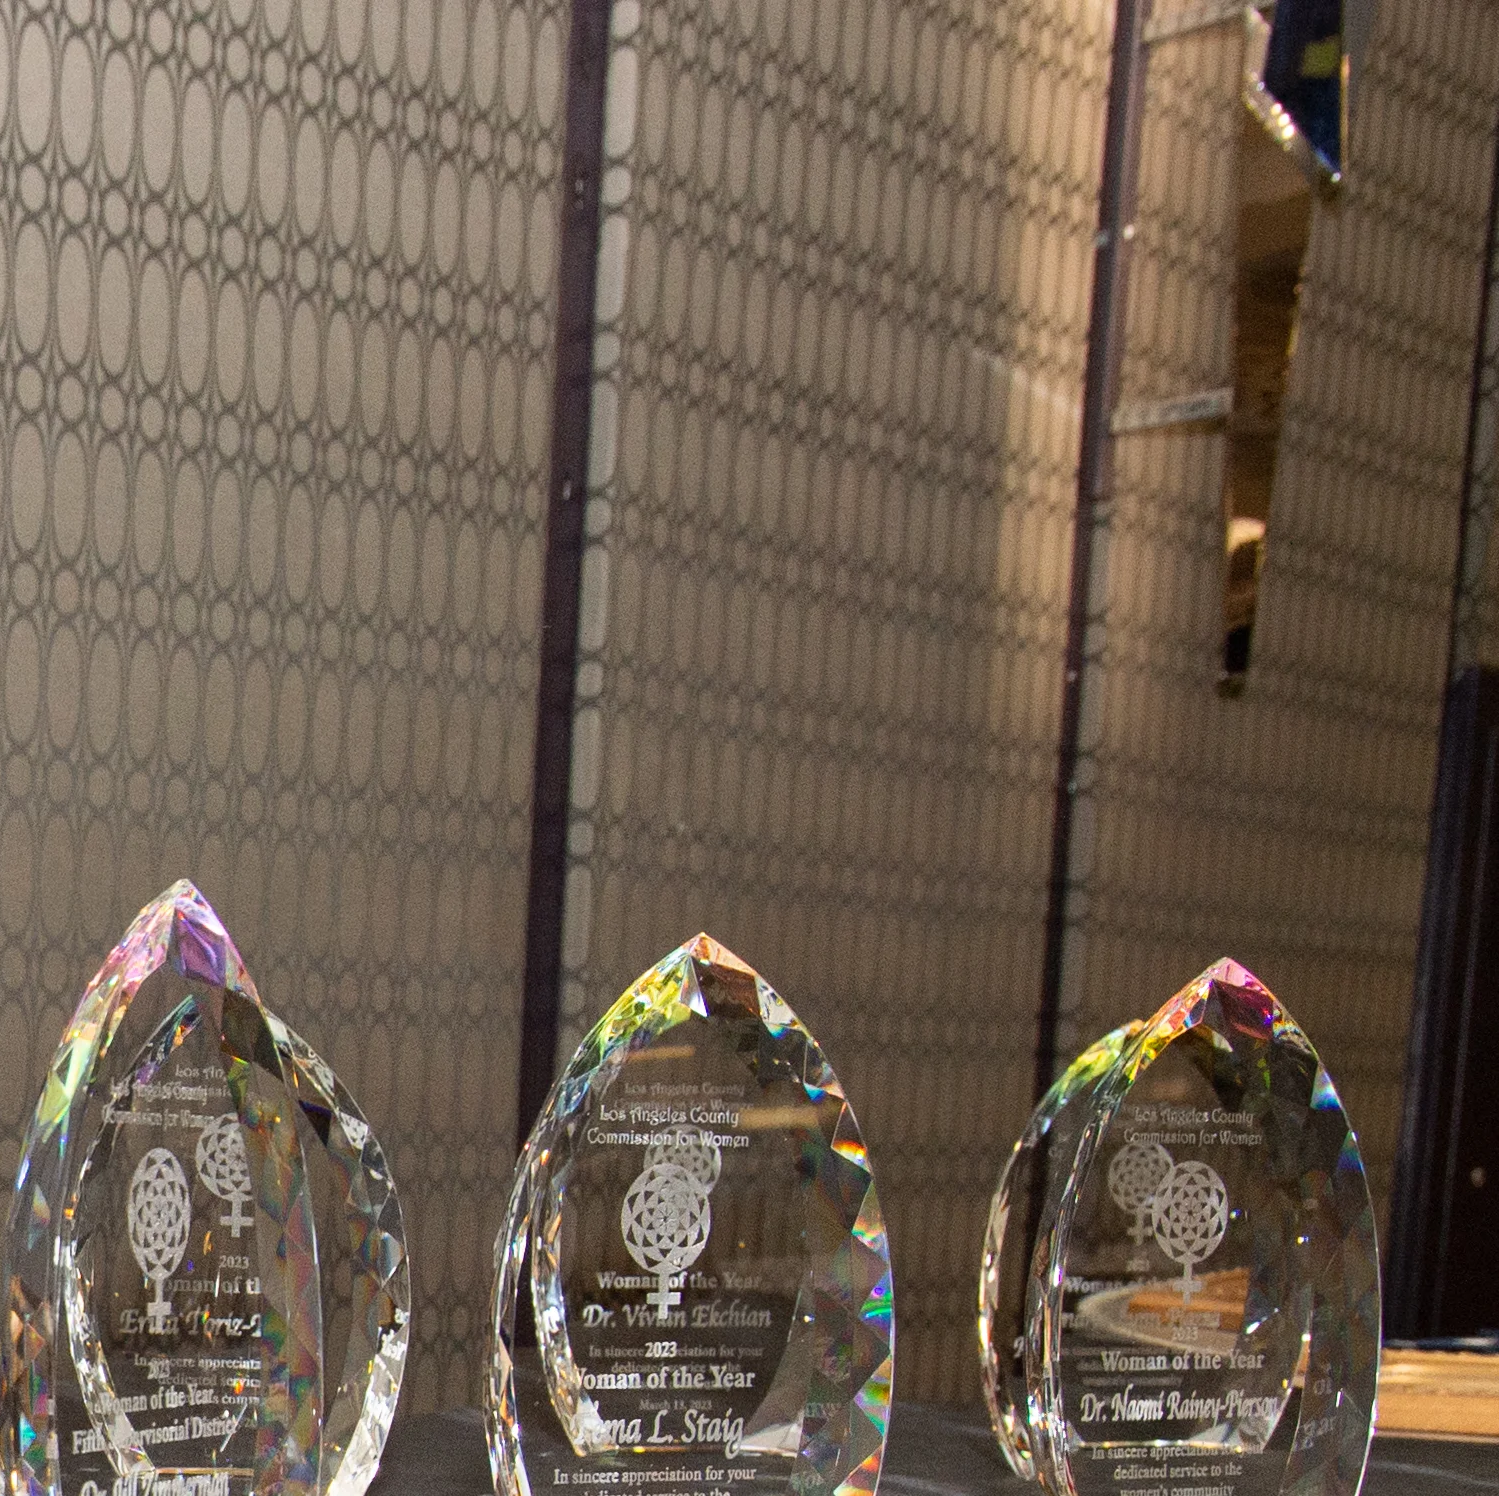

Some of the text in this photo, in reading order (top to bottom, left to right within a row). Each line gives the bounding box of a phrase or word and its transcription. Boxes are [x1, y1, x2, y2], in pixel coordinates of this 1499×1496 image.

[175, 1064, 199, 1078] Los
[600, 1105, 626, 1122] Los
[630, 1106, 686, 1125] Angeles
[690, 1106, 740, 1127] County
[1134, 1107, 1253, 1126] Los Angeles County
[587, 1127, 749, 1149] Commission for Women
[1123, 1128, 1262, 1147] Commission for Women
[219, 1255, 250, 1269] 2023
[222, 1276, 242, 1295] of
[668, 1272, 687, 1289] of
[689, 1272, 718, 1289] the
[722, 1271, 762, 1289] Year
[582, 1304, 616, 1328] Dr.
[691, 1295, 772, 1328] Ekchian
[645, 1341, 677, 1358] 2023
[1101, 1350, 1168, 1372] Woman
[1172, 1349, 1192, 1370] of
[1194, 1349, 1222, 1370] the
[1227, 1349, 1265, 1369] Year
[646, 1366, 667, 1389] of
[672, 1366, 705, 1389] the
[709, 1365, 756, 1388] Year
[151, 1387, 163, 1409] of
[166, 1385, 185, 1408] the
[188, 1383, 213, 1405] Year
[1080, 1383, 1279, 1428] Dr. Naomi Rainey-Pierson
[647, 1409, 673, 1444] L.
[681, 1408, 744, 1459] Staig
[1092, 1445, 1218, 1462] In sincere appreciation
[554, 1465, 756, 1486] In sincere appreciation for your
[1113, 1461, 1242, 1480] dedicated service to the
